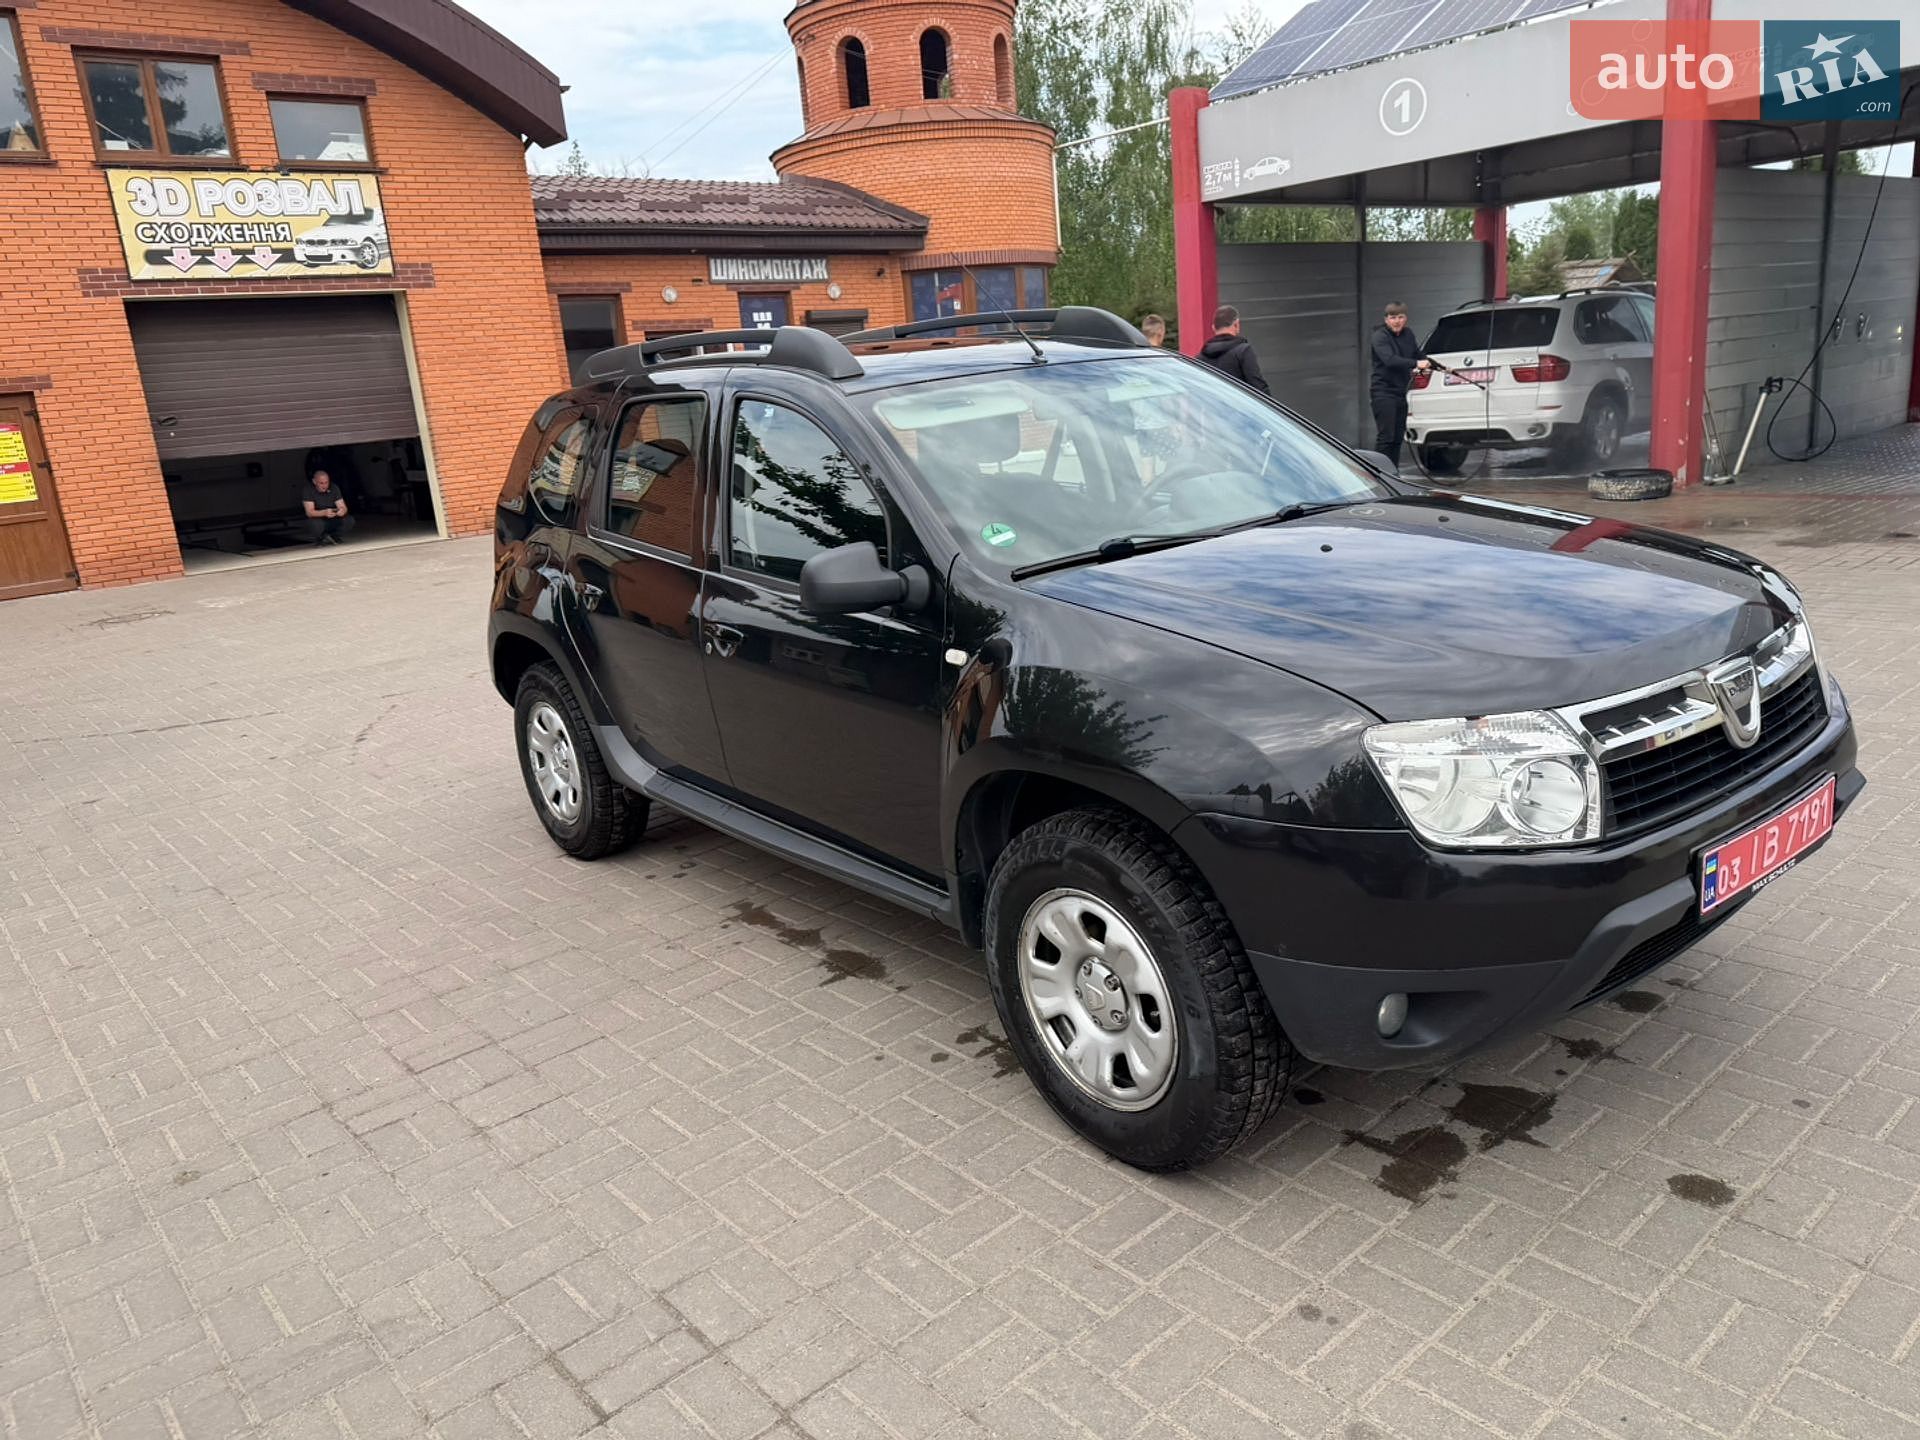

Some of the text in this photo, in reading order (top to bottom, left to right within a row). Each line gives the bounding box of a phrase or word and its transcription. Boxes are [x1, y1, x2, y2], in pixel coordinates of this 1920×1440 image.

[1394, 89, 1410, 123] 1
[126, 178, 366, 217] 3D РОЗВАЛ
[135, 222, 292, 246] СХОДЖЕННЯ
[710, 259, 828, 280] ШИНОМОНТАЖ
[1718, 856, 1741, 895] 03
[1785, 789, 1829, 854] 7191
